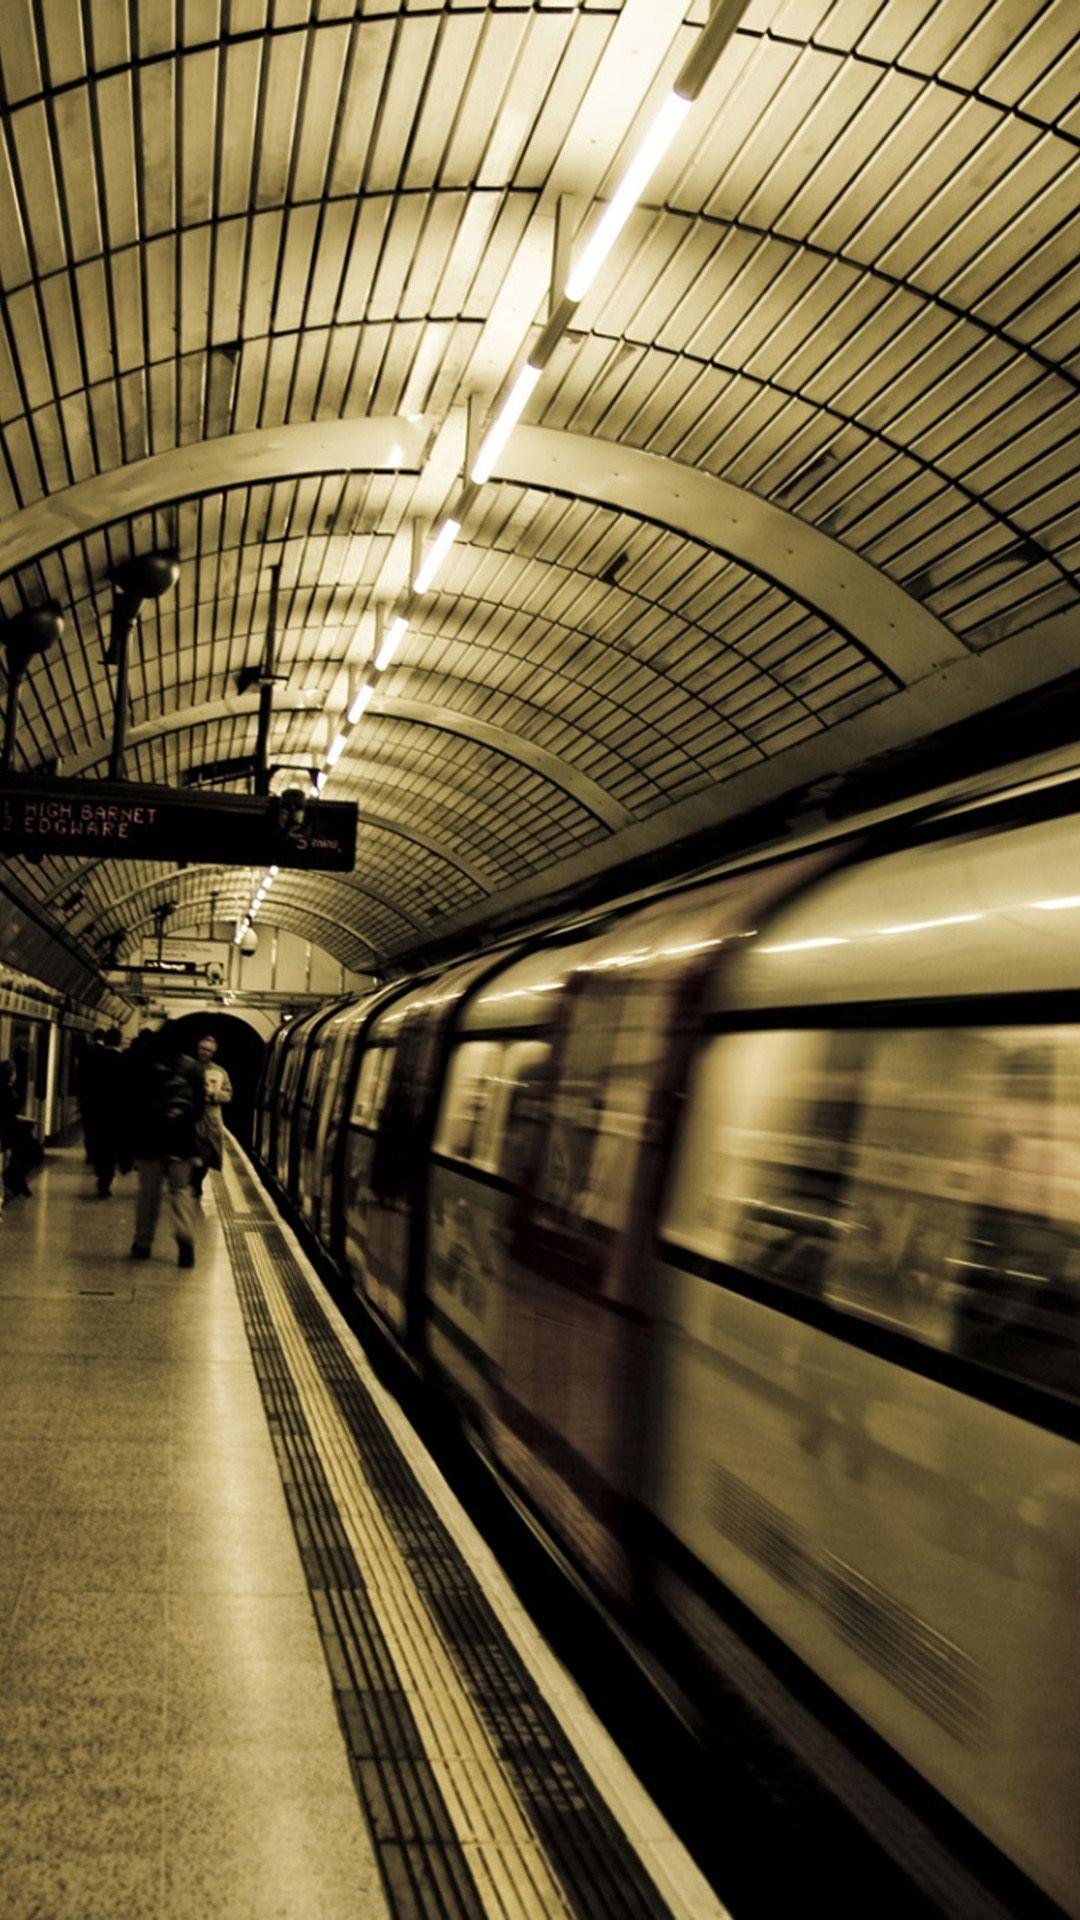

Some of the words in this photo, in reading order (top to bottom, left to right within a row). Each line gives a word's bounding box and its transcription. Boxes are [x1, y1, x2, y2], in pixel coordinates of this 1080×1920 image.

[24, 801, 73, 818] HIGH
[80, 803, 161, 825] BARNET
[24, 816, 130, 839] EDGWARE
